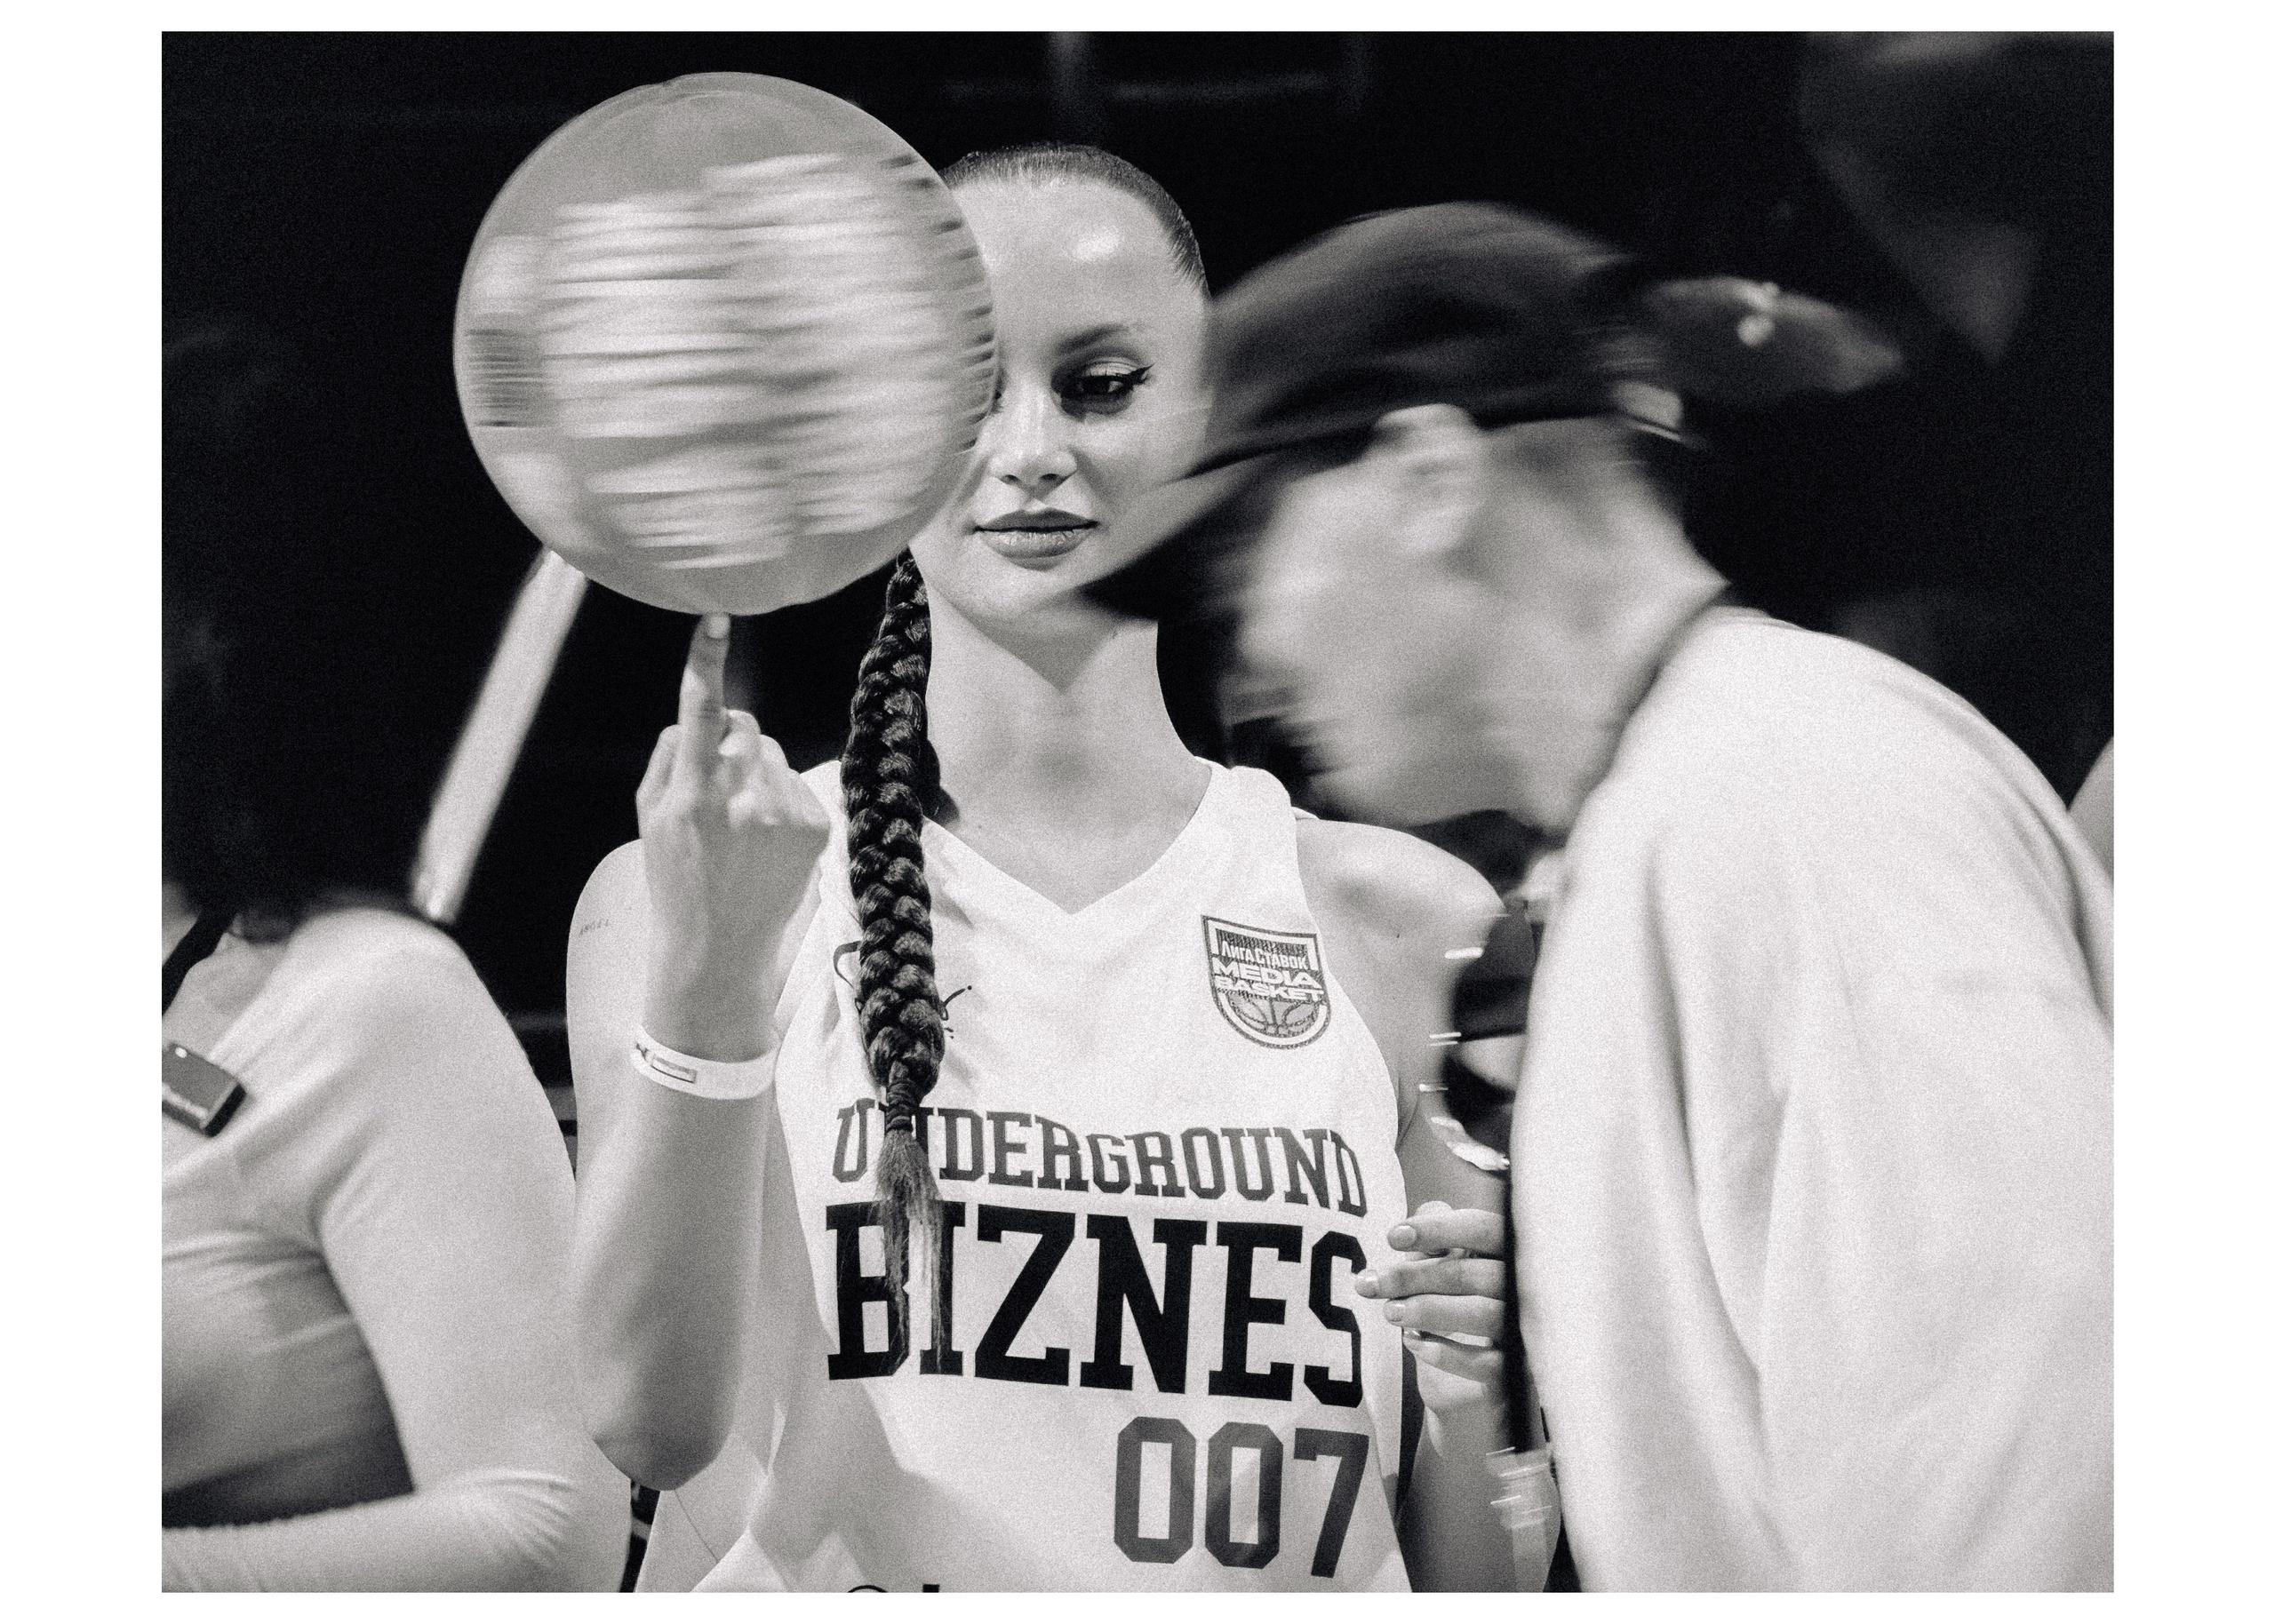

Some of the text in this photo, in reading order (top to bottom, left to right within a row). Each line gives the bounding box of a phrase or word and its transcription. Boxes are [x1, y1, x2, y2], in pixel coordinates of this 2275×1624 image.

[1221, 940, 1254, 962] ЛИГА
[1212, 957, 1322, 989] MEDIA
[1215, 975, 1325, 1002] BASKET
[826, 1200, 1367, 1408] BIZNES
[1114, 1417, 1369, 1579] 007
